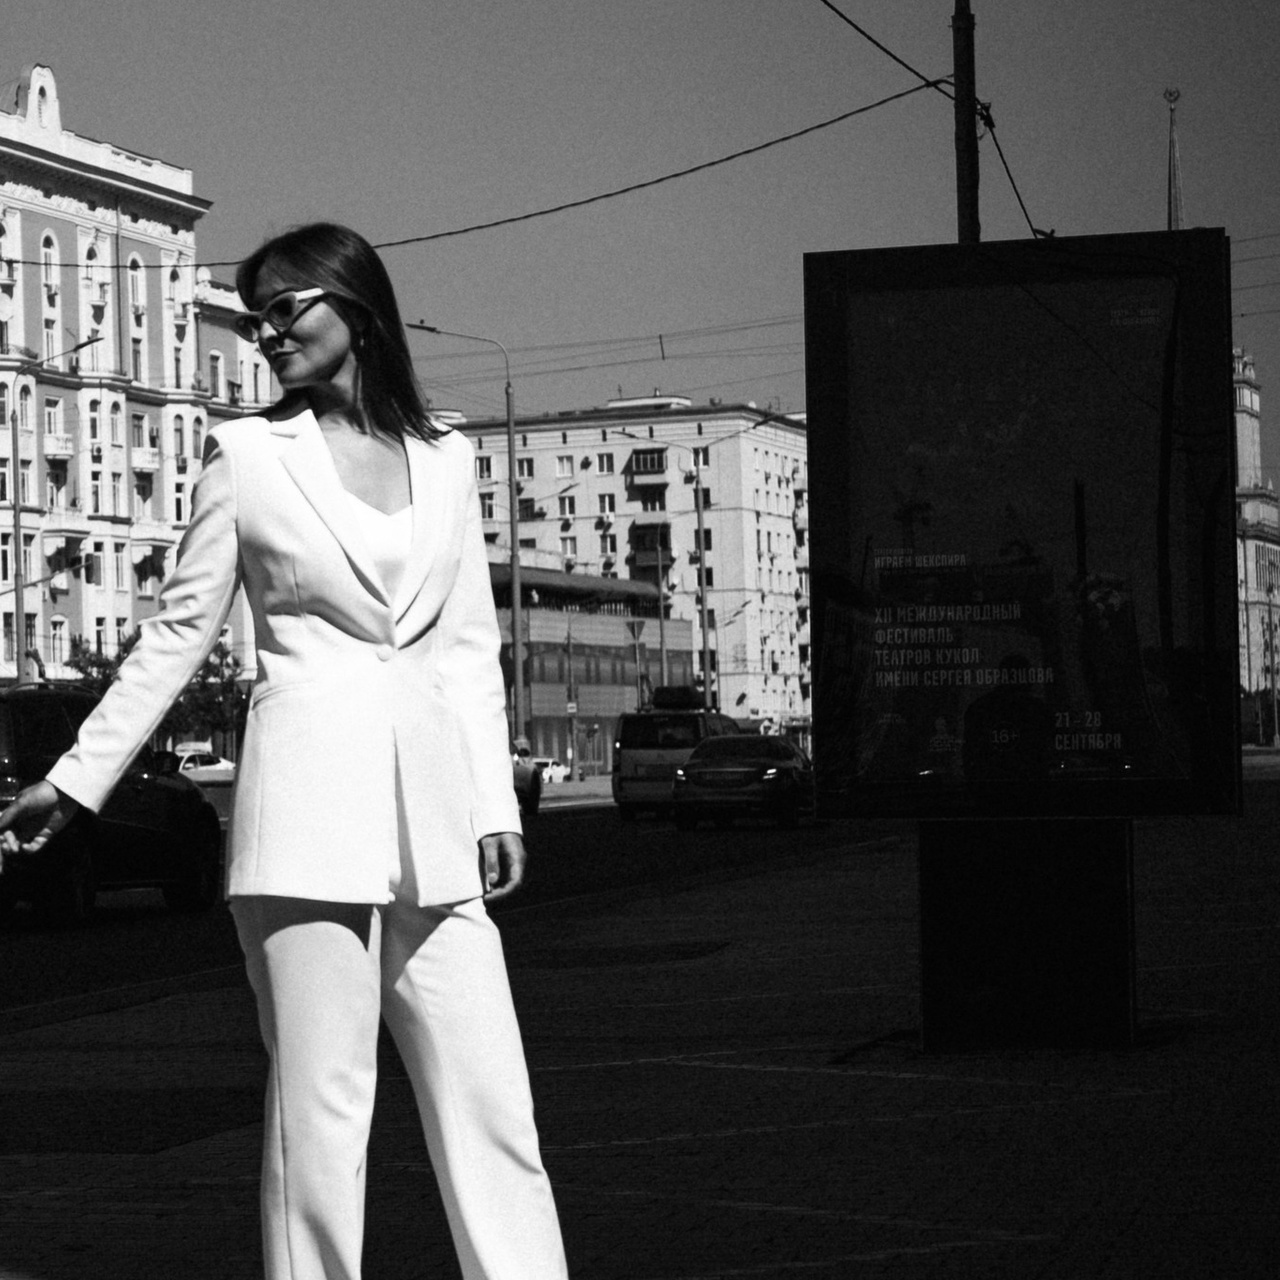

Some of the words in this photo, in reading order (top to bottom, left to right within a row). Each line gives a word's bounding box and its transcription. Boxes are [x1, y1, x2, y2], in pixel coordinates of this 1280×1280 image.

[874, 556, 912, 569] ИГРАЕМ
[915, 554, 966, 568] ШЕКСПИРА
[897, 601, 1022, 623] МЕЖДУНАРОДНЫЙ
[874, 627, 954, 645] ФЕСТИВАЛЬ
[874, 648, 931, 666] ТЕАТРОВ
[936, 648, 980, 665] КУКОЛ
[875, 670, 919, 688] ИМЕНИ
[923, 669, 971, 686] СЕРГЕЯ
[975, 667, 1054, 685] ОБРАЗЦОВА
[1054, 712, 1070, 728] 21
[1085, 710, 1102, 727] 28
[991, 729, 1019, 744] 16+
[1054, 733, 1122, 751] СЕНТЯБРЯ
